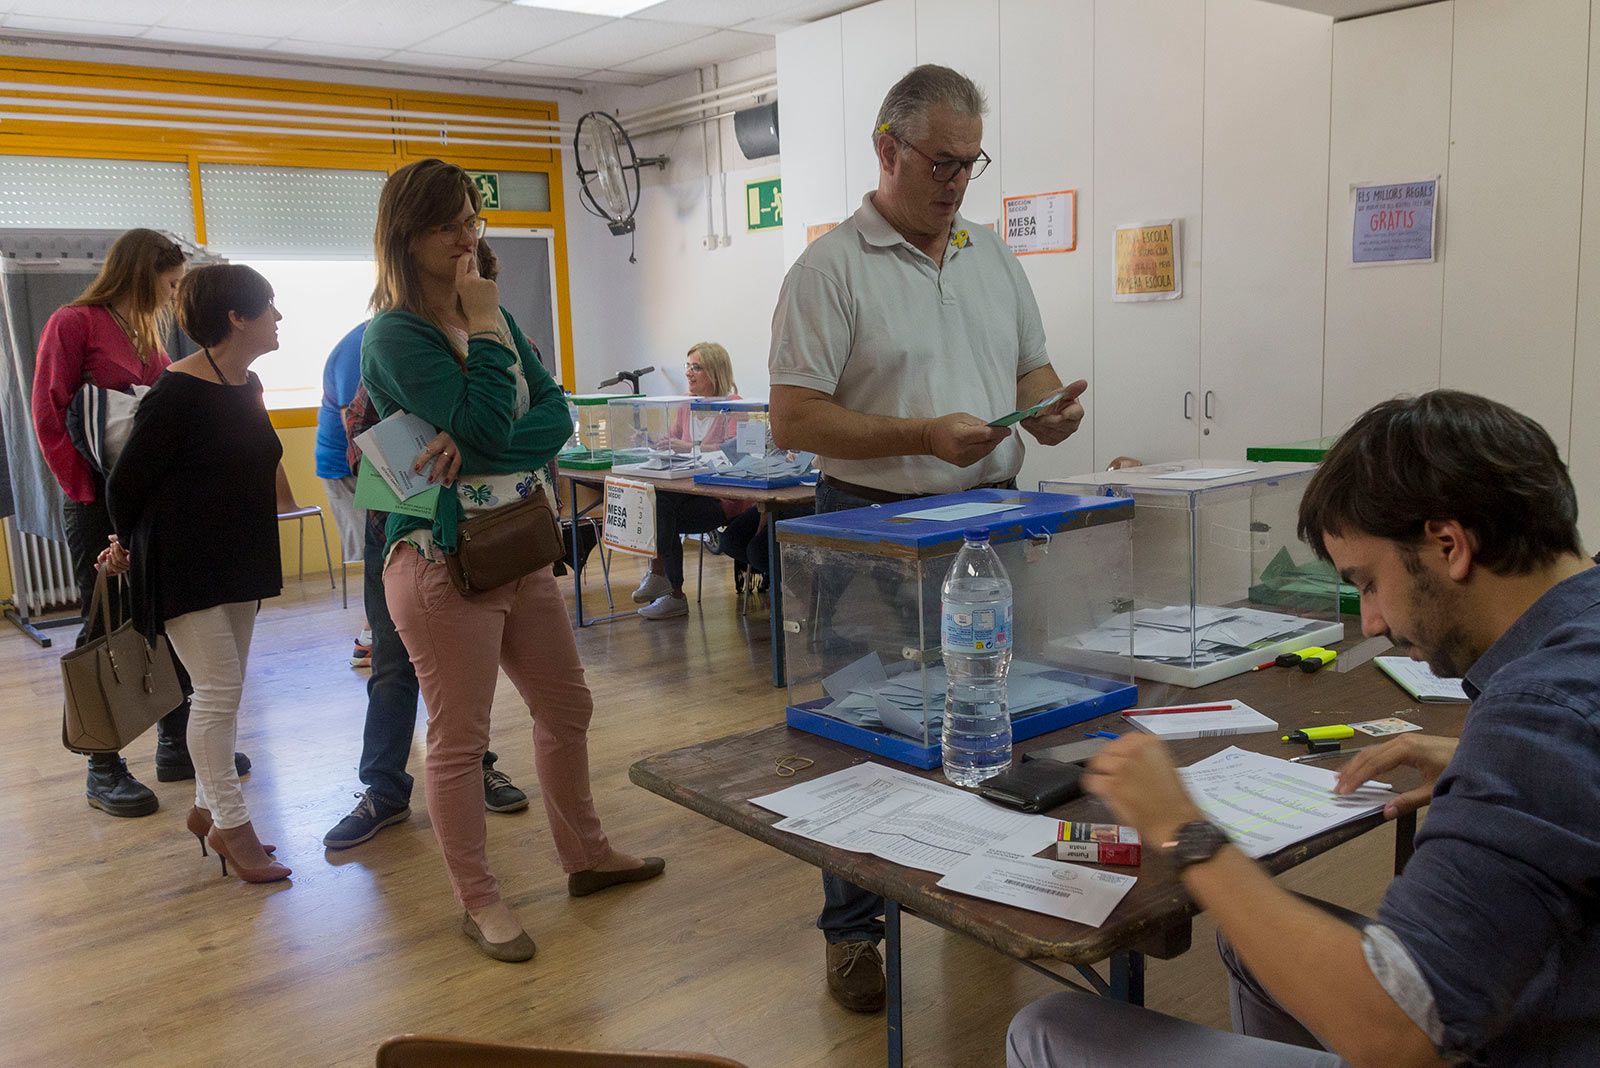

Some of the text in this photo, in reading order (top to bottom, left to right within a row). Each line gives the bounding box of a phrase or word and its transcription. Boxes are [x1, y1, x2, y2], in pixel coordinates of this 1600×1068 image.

[1405, 184, 1433, 199] REGALS
[1008, 215, 1037, 228] MESA
[1370, 209, 1415, 232] GRATIS
[1008, 226, 1037, 238] MESA
[1142, 229, 1169, 244] ESCOLA
[1145, 274, 1172, 289] ESCOLA
[608, 504, 627, 518] MESA
[607, 515, 626, 529] MESA
